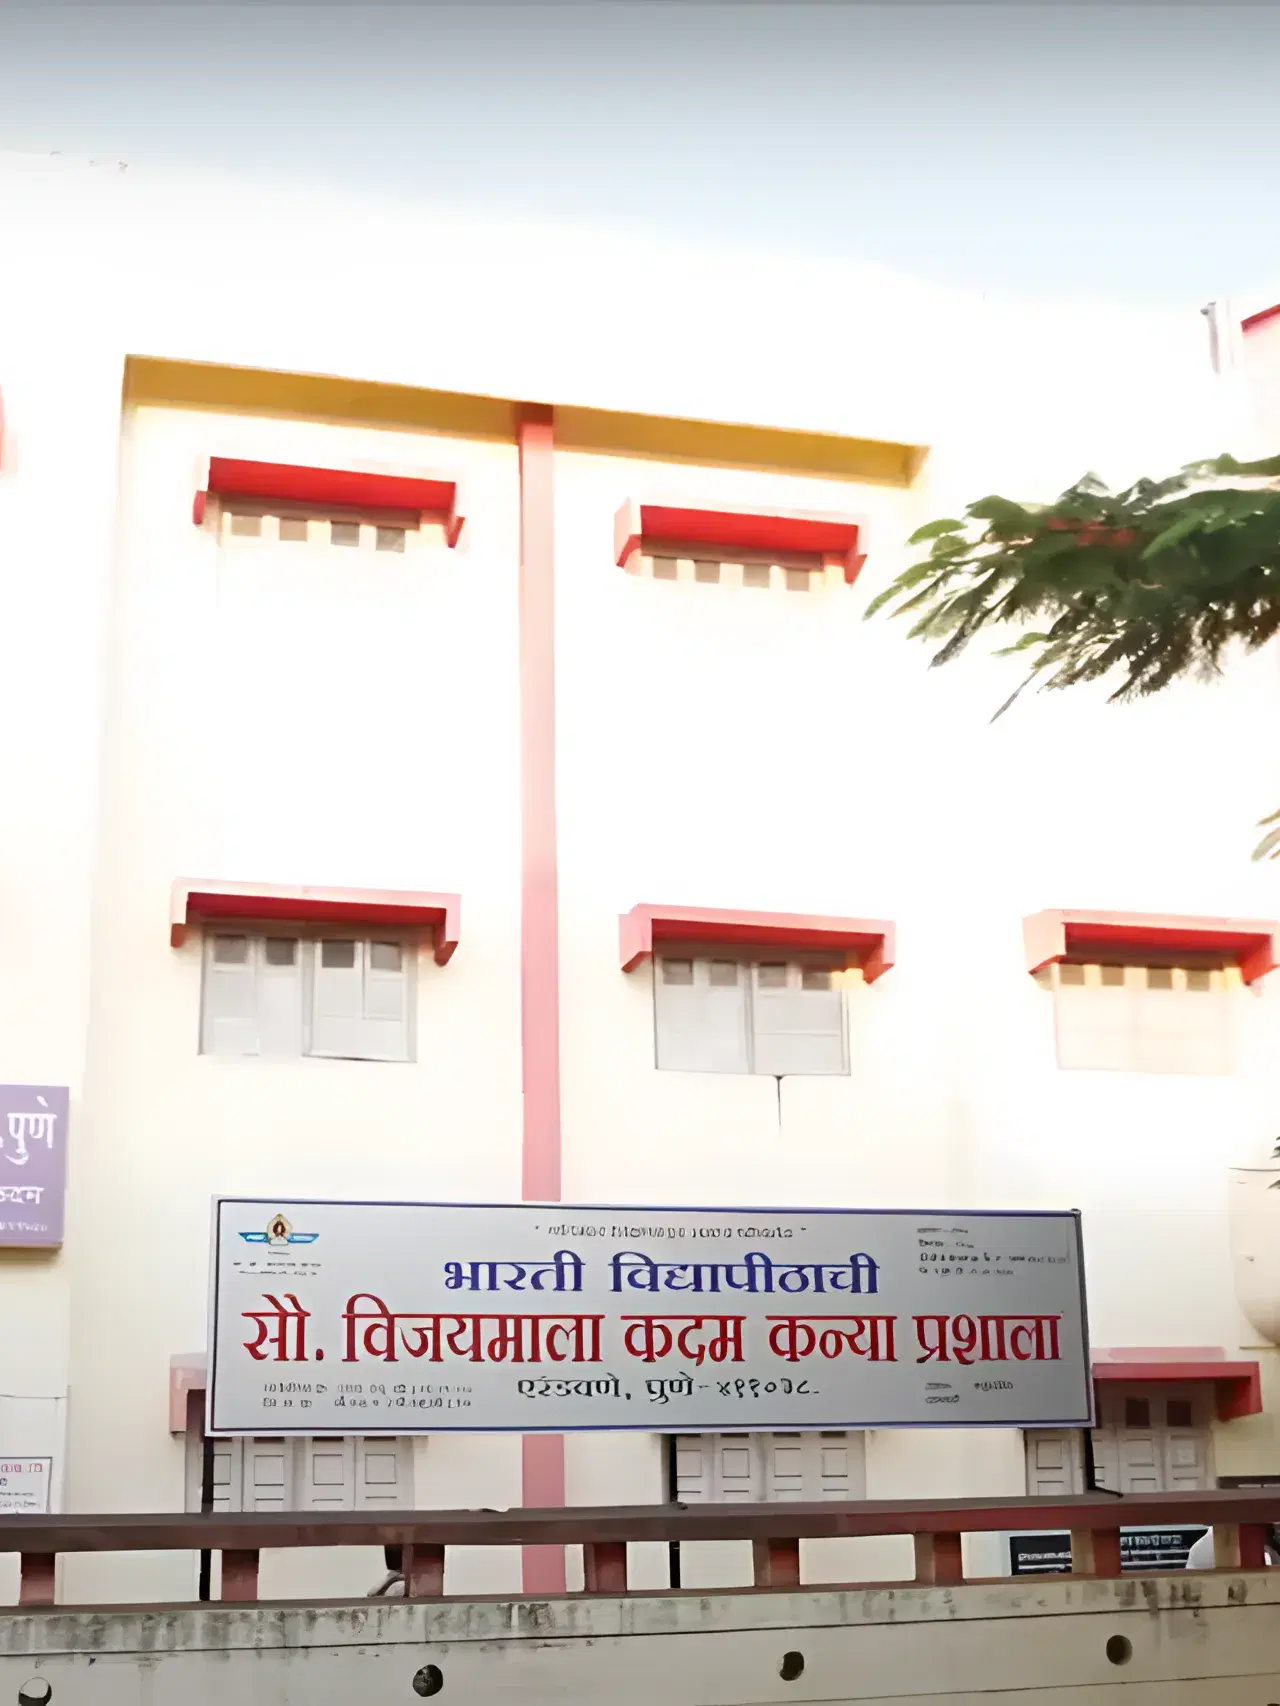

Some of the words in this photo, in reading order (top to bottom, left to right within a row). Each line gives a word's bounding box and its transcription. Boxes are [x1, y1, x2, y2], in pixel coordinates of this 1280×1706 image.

[444, 1250, 586, 1293] भारती
[608, 1251, 880, 1294] विद्यापीठाची
[241, 1293, 325, 1362] सौ.
[341, 1293, 606, 1364] विजयमाला
[620, 1313, 747, 1366] कदम
[765, 1315, 898, 1363] कन्या
[913, 1313, 1064, 1365] प्रशाला
